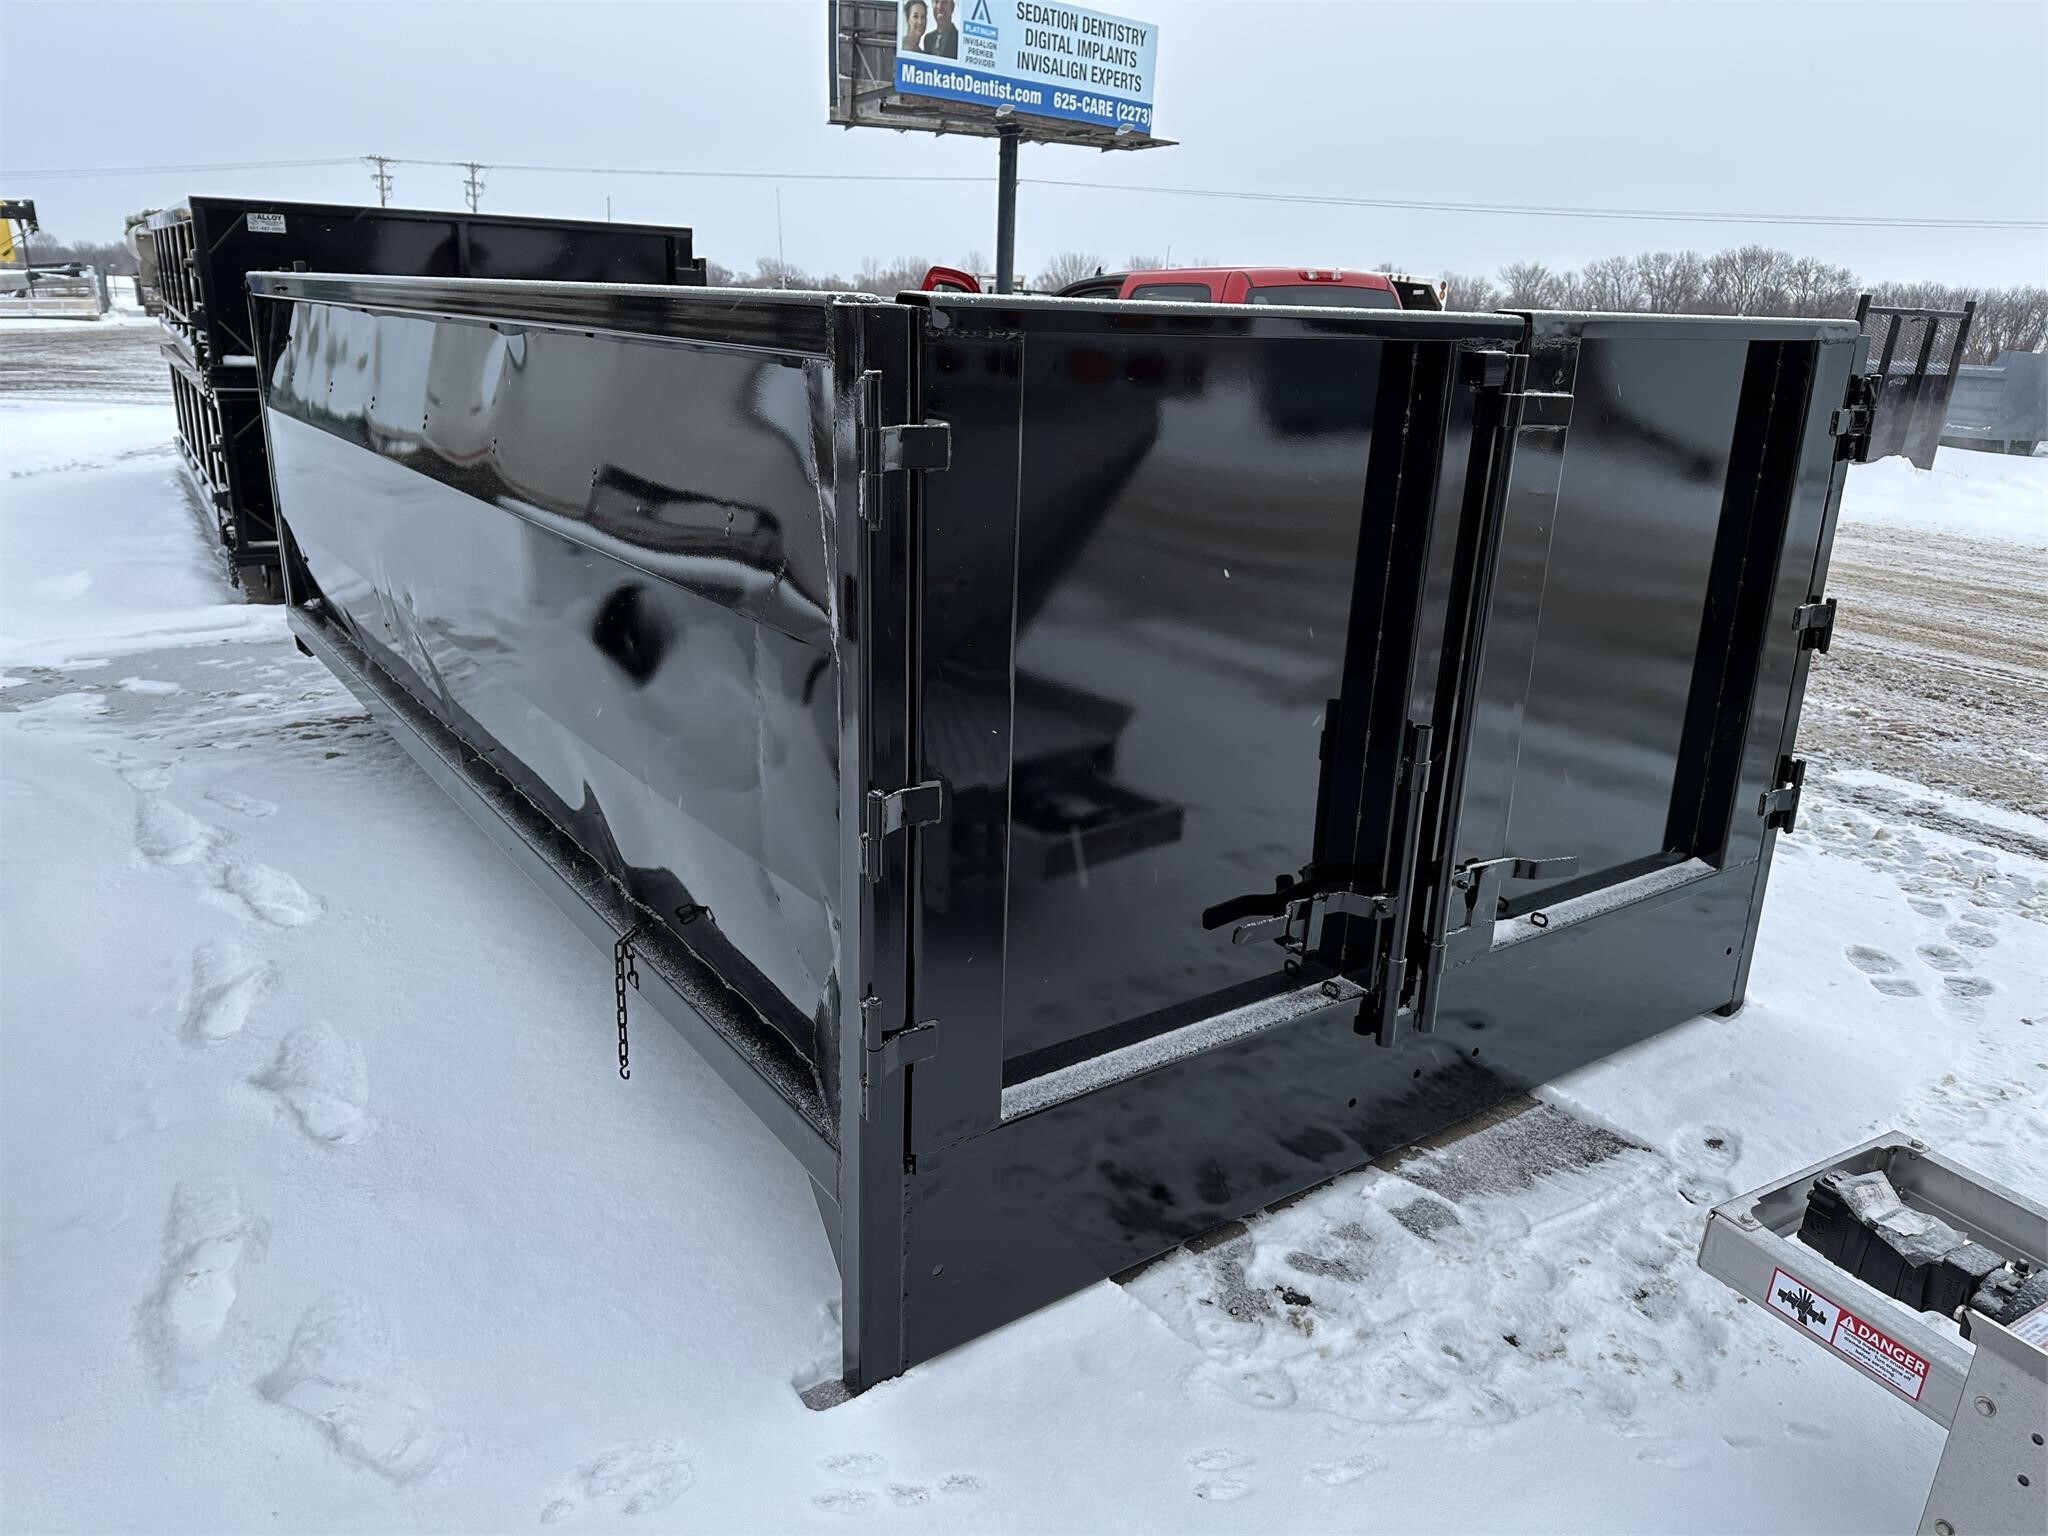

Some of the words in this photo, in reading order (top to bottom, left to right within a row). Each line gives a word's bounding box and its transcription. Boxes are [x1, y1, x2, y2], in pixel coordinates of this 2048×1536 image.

[962, 36, 997, 50] INVISALIGN
[1016, 1, 1079, 32] SEDATION
[1082, 15, 1147, 47] DENTISTRY
[964, 55, 996, 68] PROVIDER
[967, 46, 994, 58] PREMIER
[1025, 28, 1074, 55] DIGITAL
[1077, 38, 1138, 68] IMPLANTS
[1017, 50, 1088, 81] INVISALIGN
[1091, 65, 1142, 92] EXPERTS
[901, 64, 1042, 105] MankatoDentist.com
[1052, 91, 1113, 118] 625-CARE
[1116, 102, 1151, 126] (2273)
[1857, 1324, 1926, 1376] DANGER
